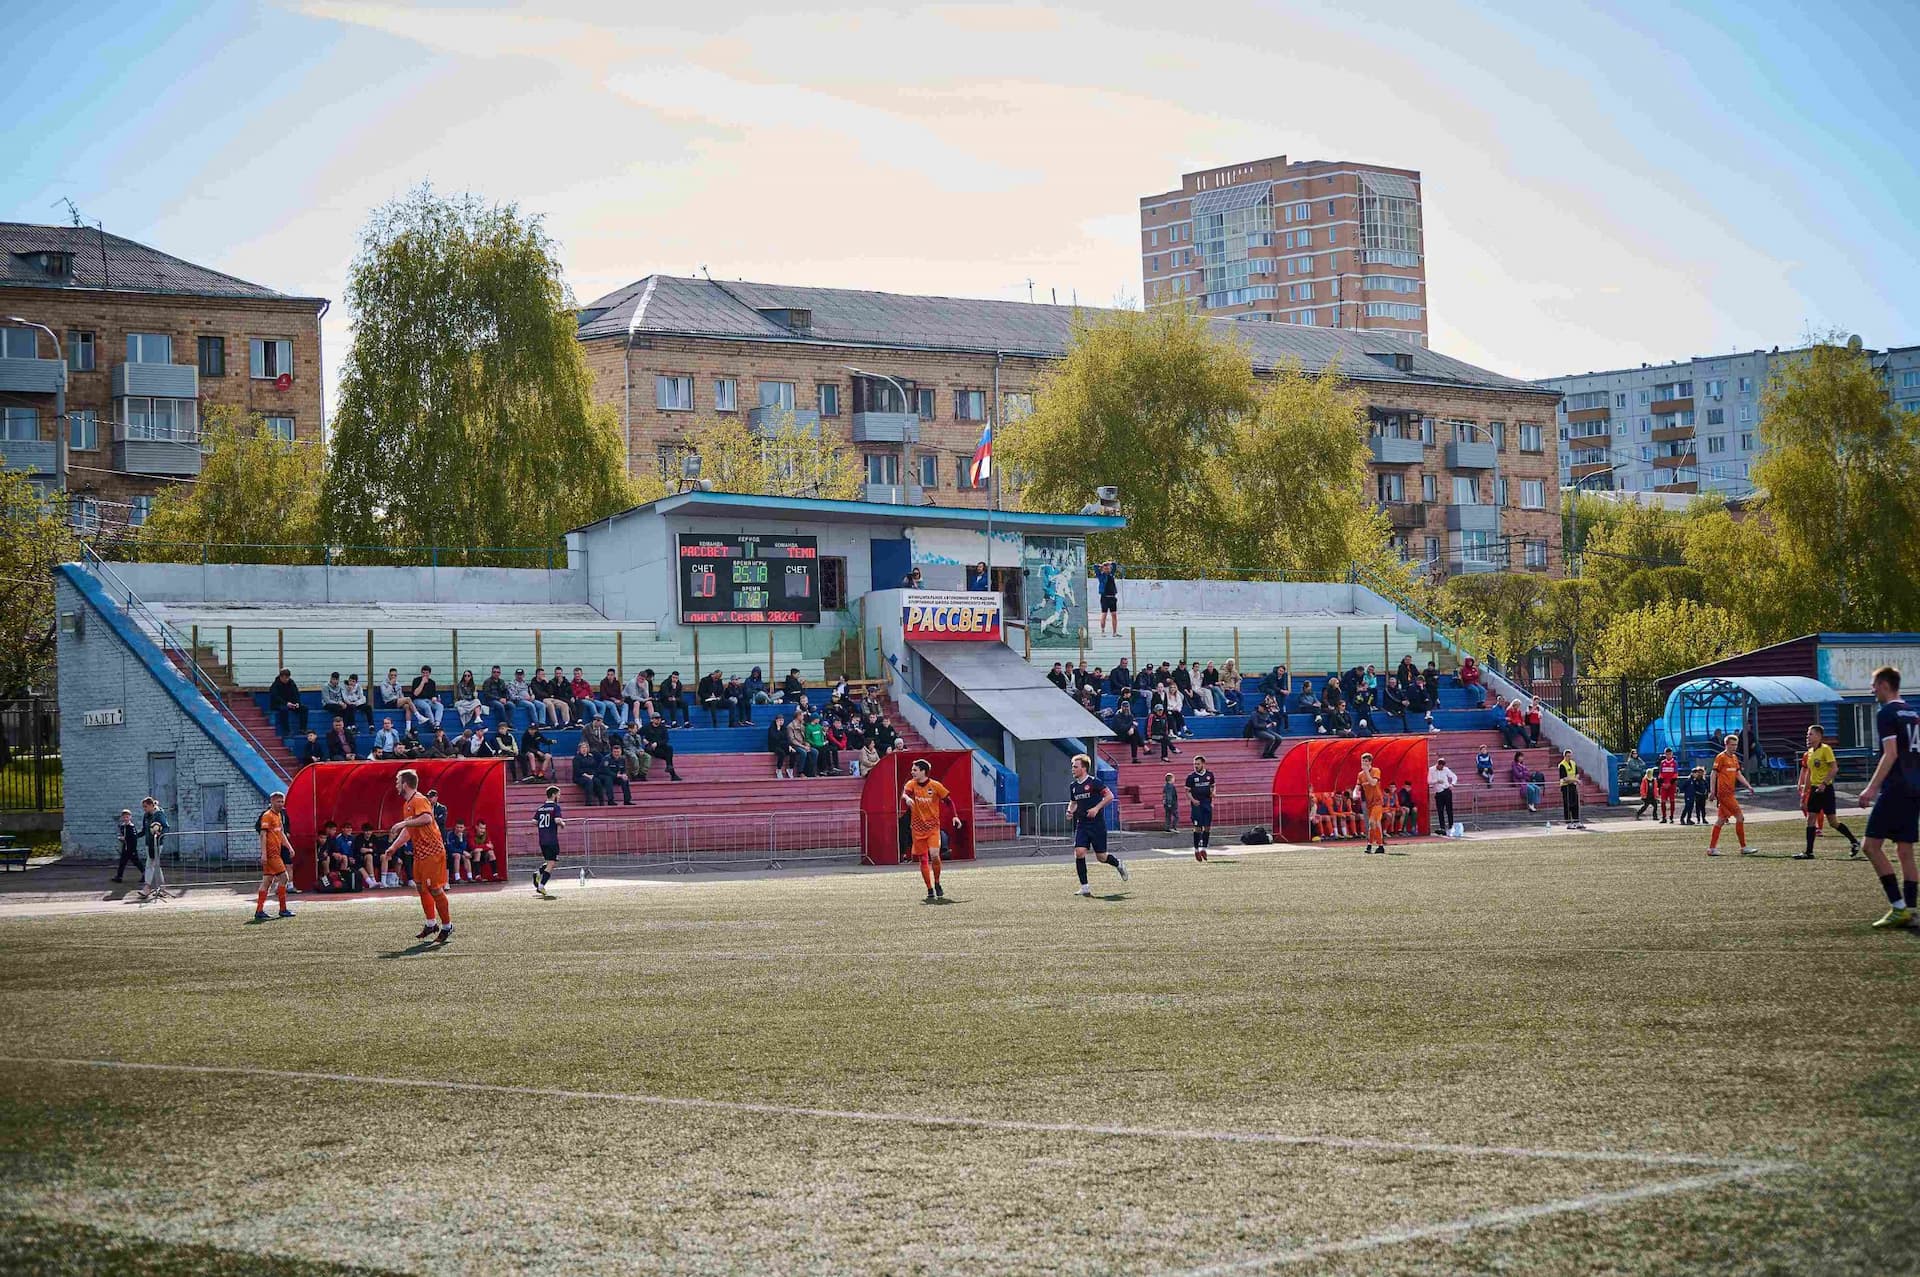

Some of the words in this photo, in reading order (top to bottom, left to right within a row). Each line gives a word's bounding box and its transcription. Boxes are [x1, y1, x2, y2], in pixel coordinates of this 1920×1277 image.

[680, 546, 729, 557] РАССВЕТ
[786, 547, 816, 559] ТЕМП
[691, 564, 715, 573] СЧЕТ
[785, 565, 808, 574] СЧЕТ
[703, 573, 716, 597] 0
[907, 607, 997, 632] РАССВЕТ
[539, 813, 550, 828] 20
